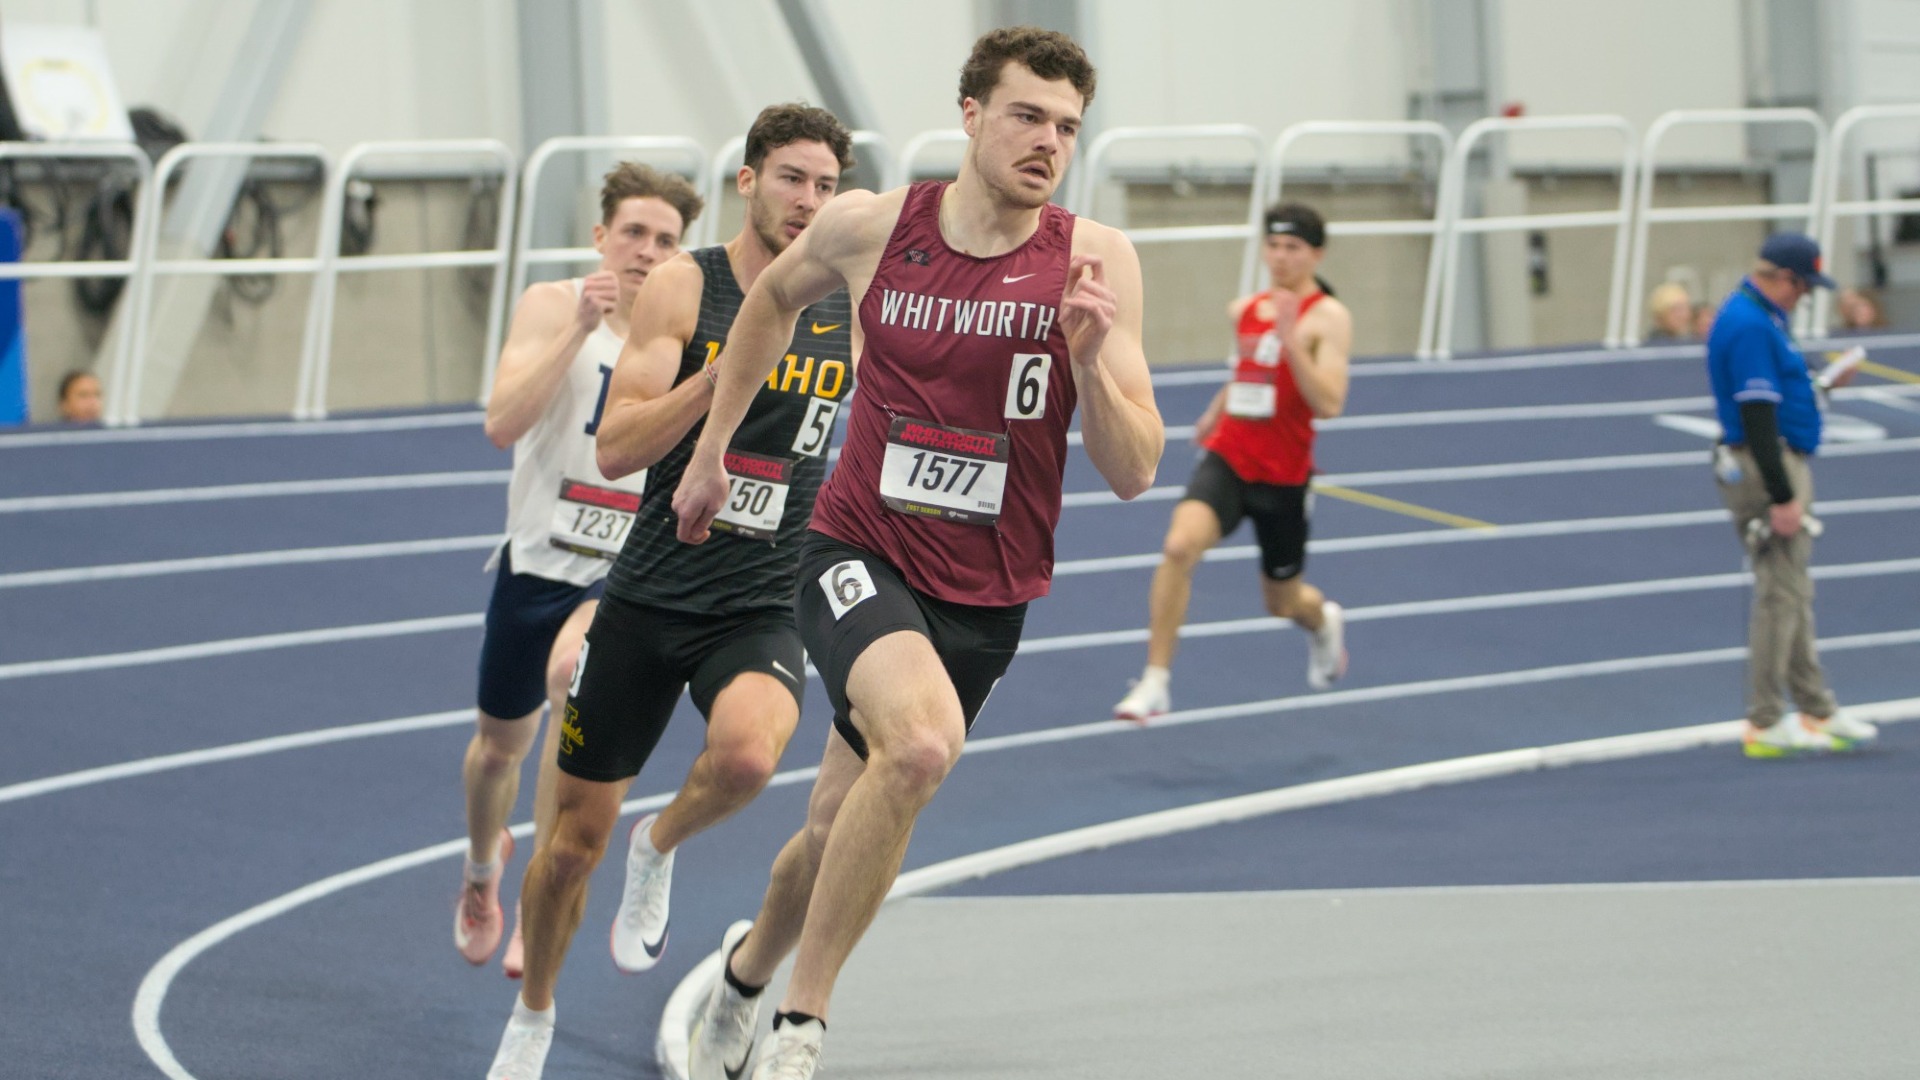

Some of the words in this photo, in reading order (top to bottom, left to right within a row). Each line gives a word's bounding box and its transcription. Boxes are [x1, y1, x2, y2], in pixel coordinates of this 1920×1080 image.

[880, 289, 1056, 341] WHITWORTH
[705, 341, 846, 399] IHO
[1016, 356, 1043, 416] 6
[801, 403, 834, 453] 5
[900, 431, 998, 456] INVITATIONAL
[905, 422, 996, 450] WHITWORTH
[907, 451, 987, 496] 1577
[571, 506, 632, 542] 1237
[832, 563, 863, 607] 6
